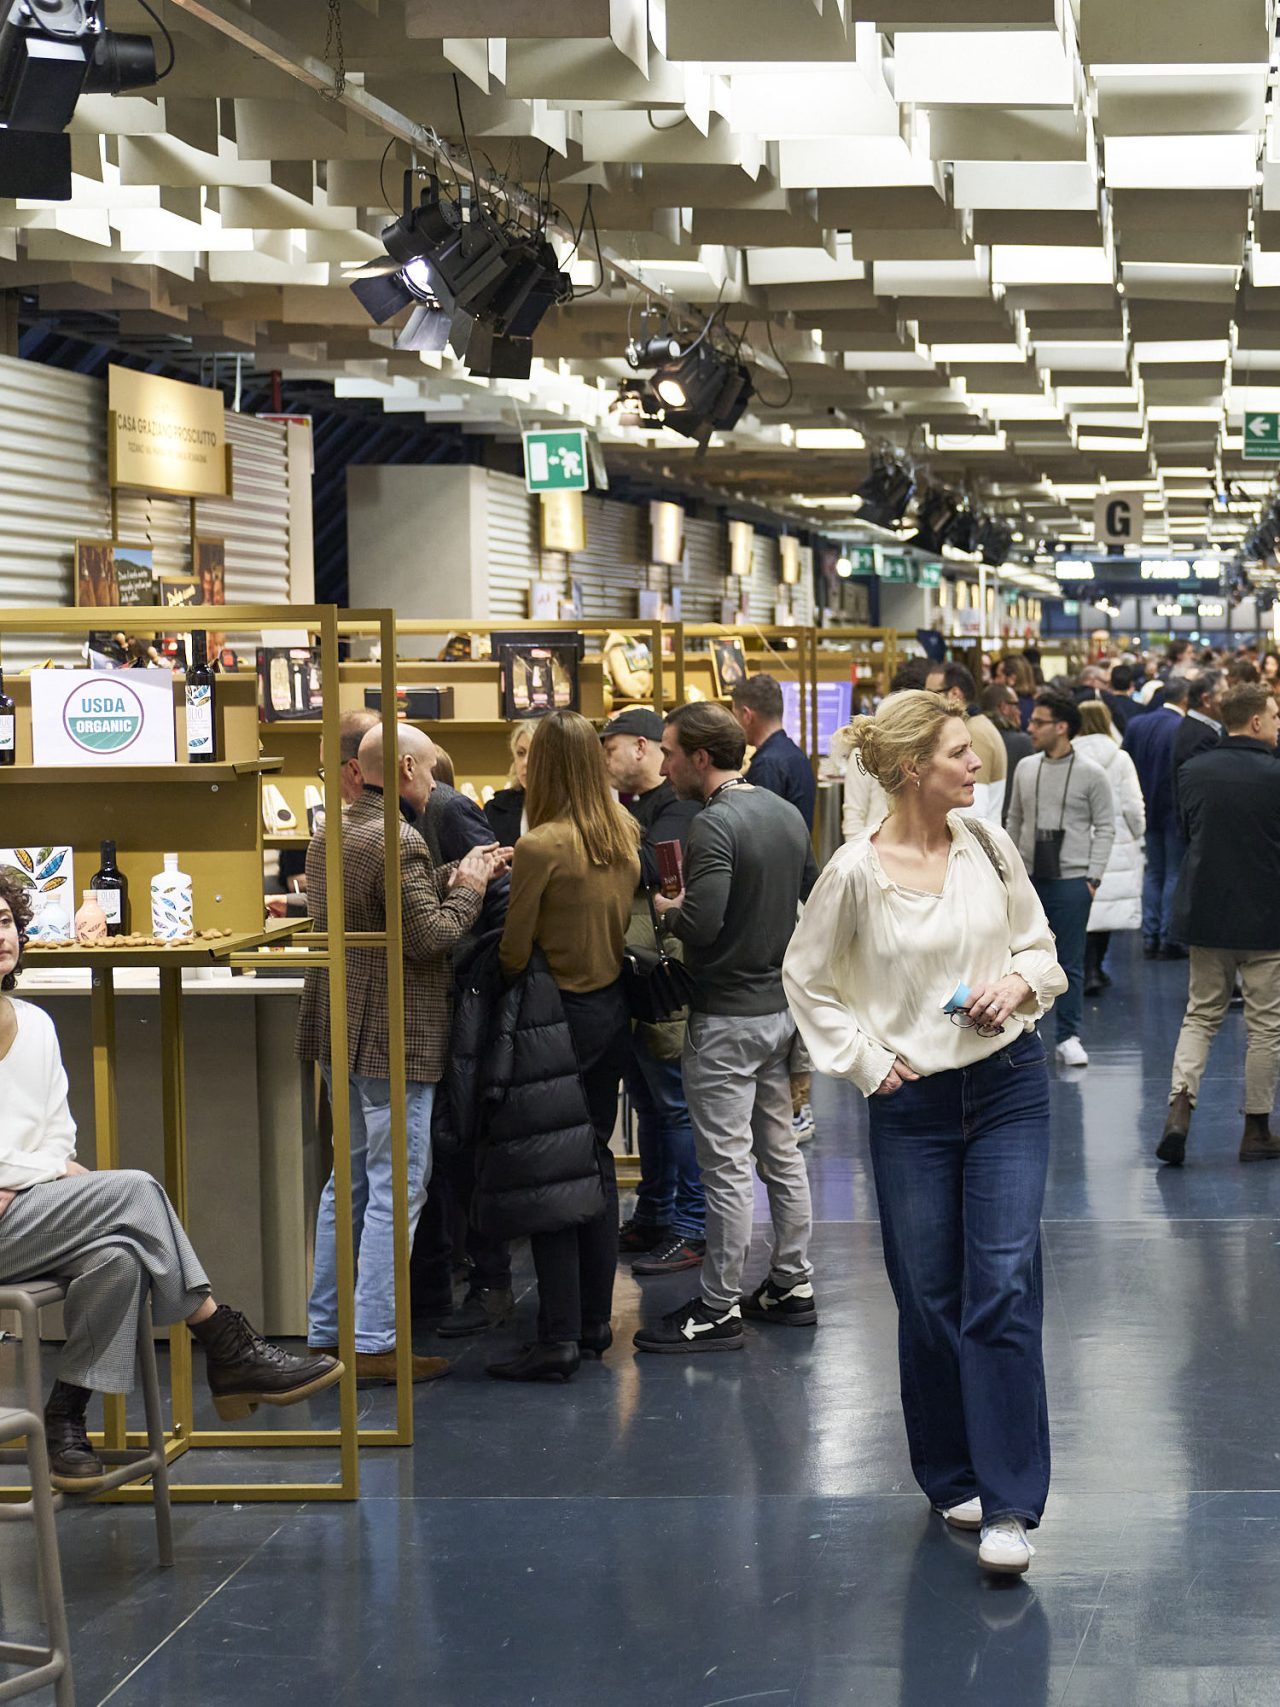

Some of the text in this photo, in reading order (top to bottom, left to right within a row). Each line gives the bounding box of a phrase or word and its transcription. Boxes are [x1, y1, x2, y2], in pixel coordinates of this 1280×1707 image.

[117, 413, 136, 433] CASA
[174, 425, 217, 447] PROSCIUTTO
[1106, 500, 1131, 537] G
[82, 698, 126, 713] USDA
[76, 719, 132, 733] ORGANIC
